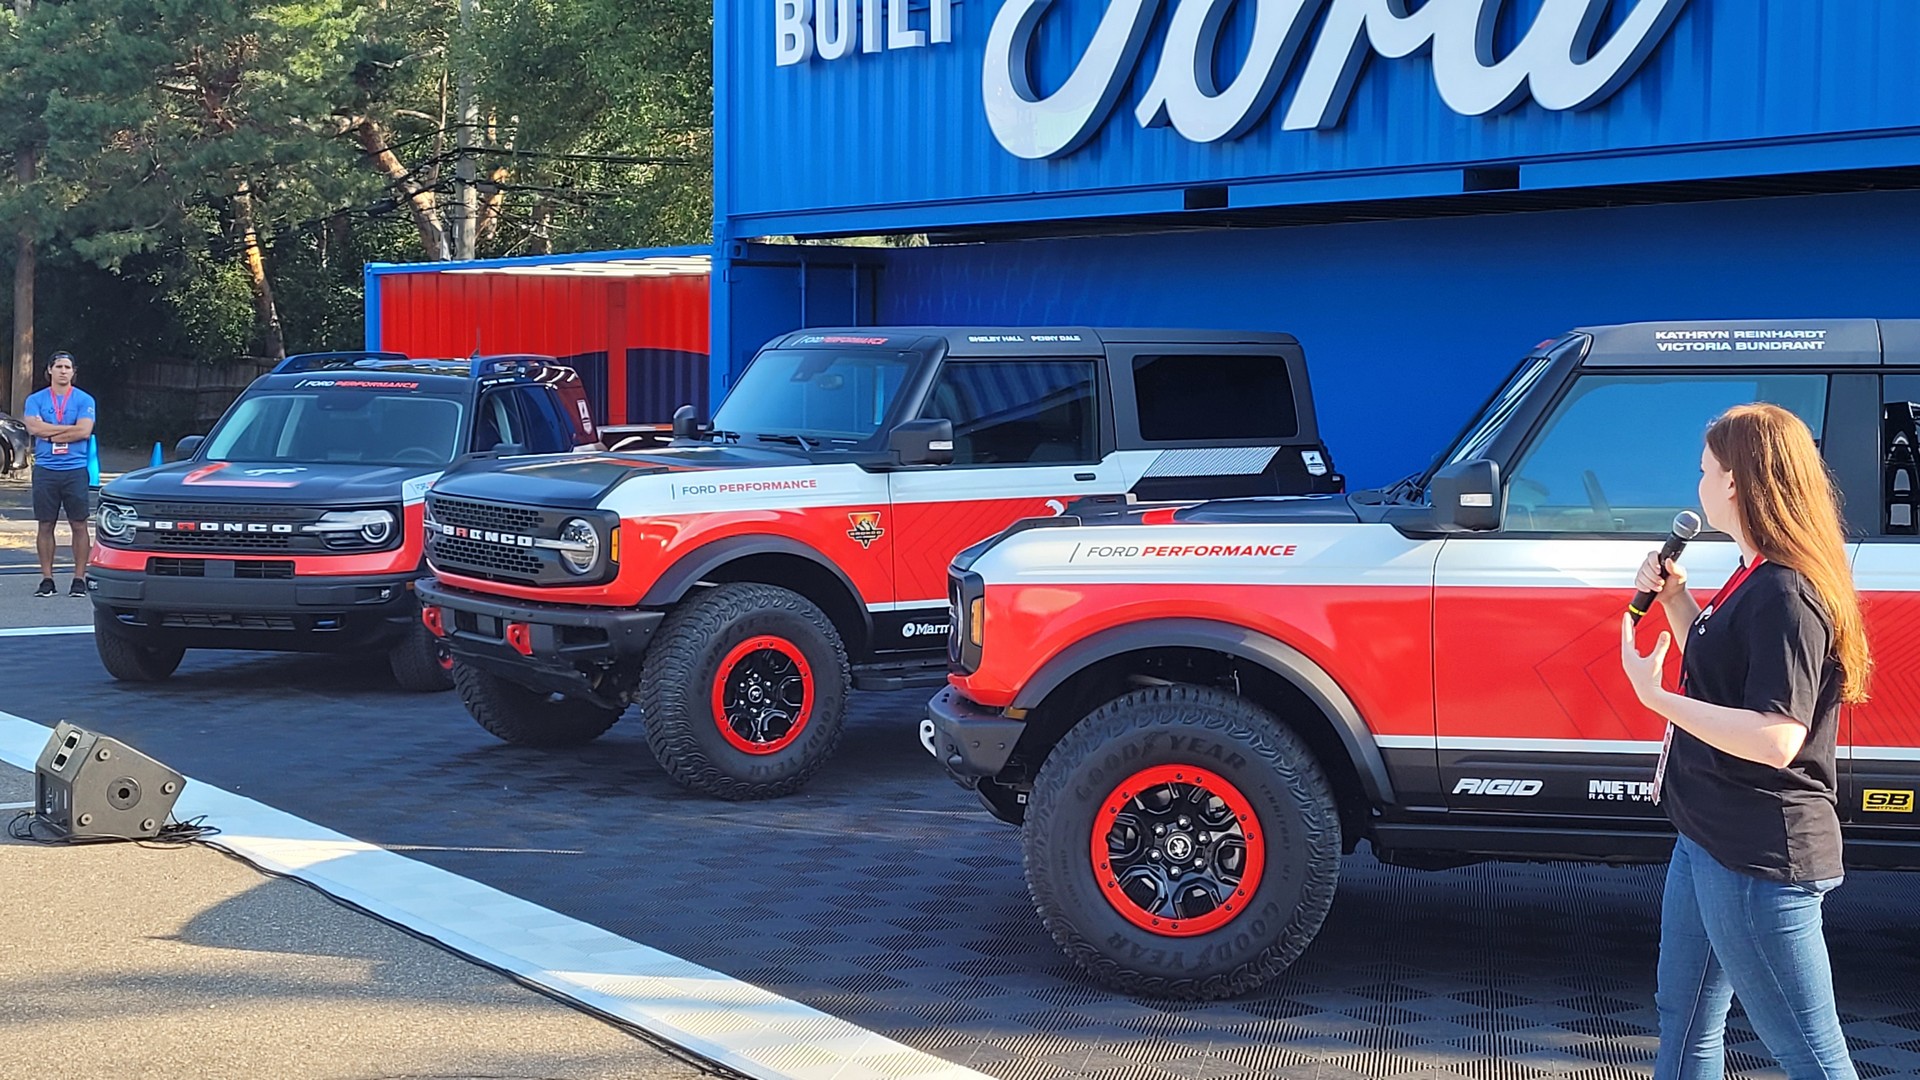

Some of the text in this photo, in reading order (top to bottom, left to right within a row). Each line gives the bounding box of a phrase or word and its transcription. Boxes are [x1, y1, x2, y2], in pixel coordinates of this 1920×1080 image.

[1655, 330, 1827, 340] KATHRYN REINHARDT
[1657, 341, 1825, 351] VICTORIA BUNDRANT
[682, 479, 817, 496] FORD PERFORMANCE
[154, 520, 293, 533] BRONCO
[442, 525, 533, 547] BRONCO
[1087, 545, 1298, 557] FORD PERFORMANCE
[1452, 778, 1543, 796] RIGID
[1866, 792, 1911, 806] SB
